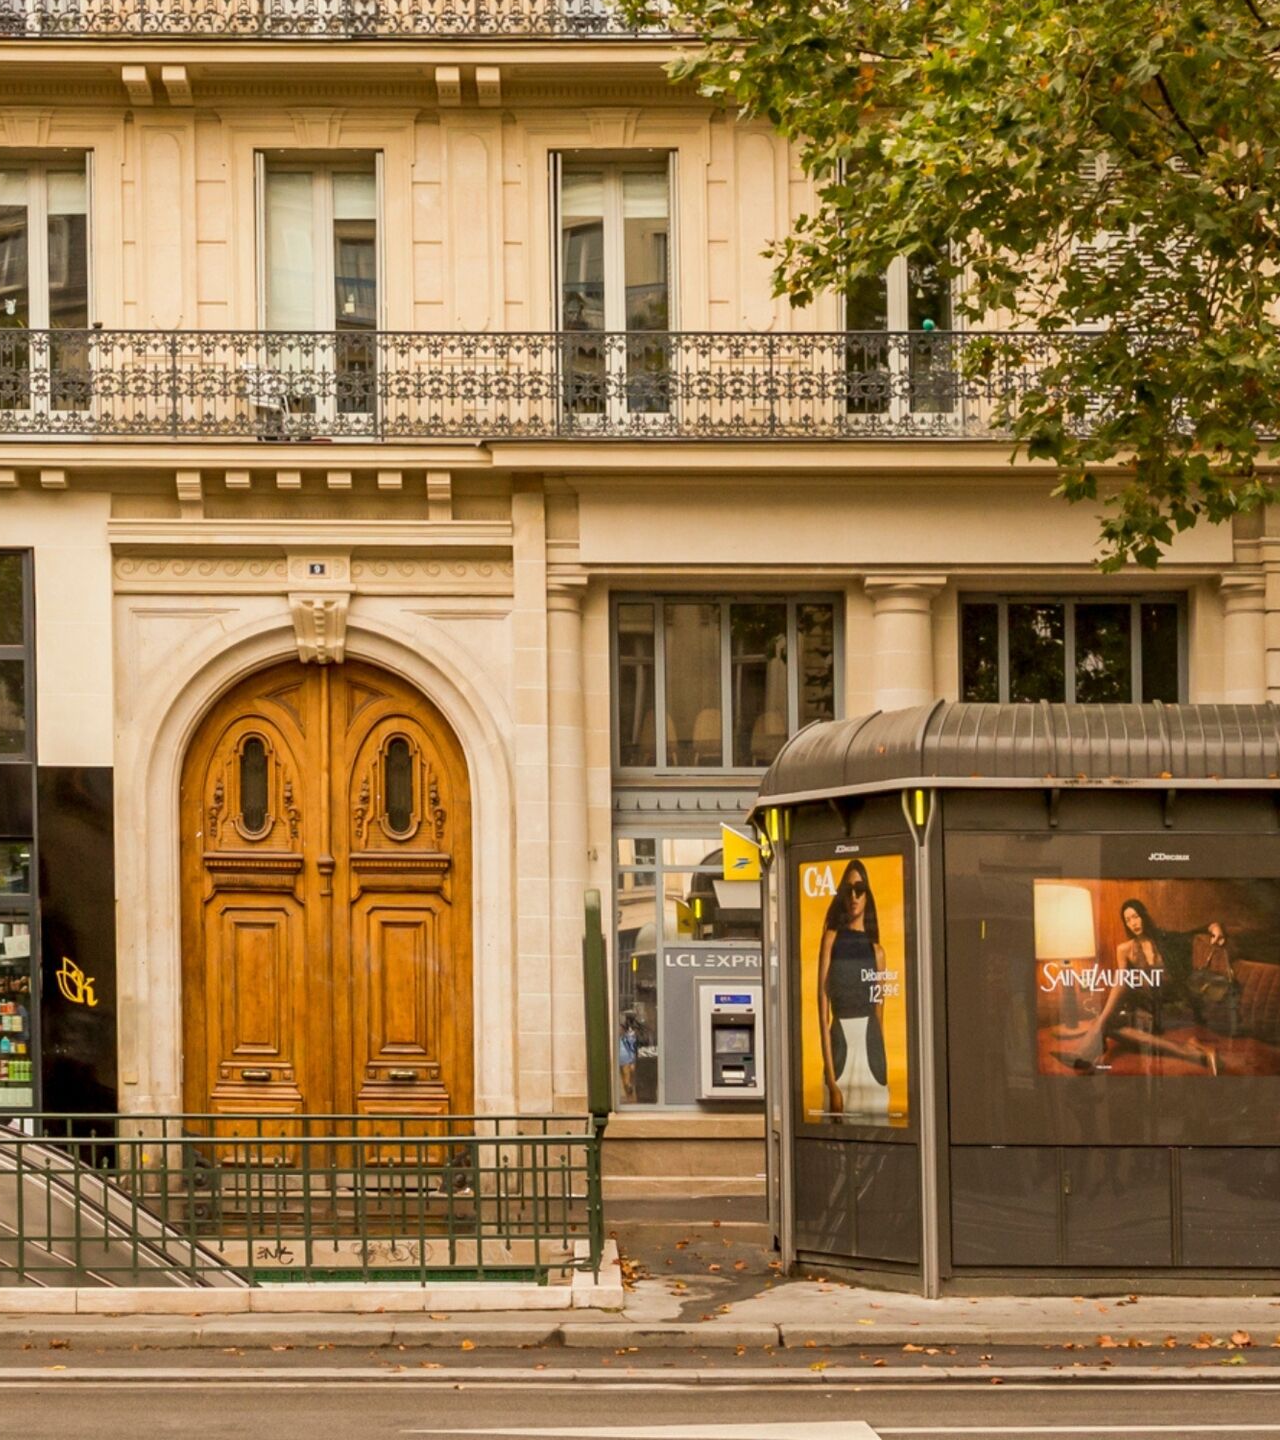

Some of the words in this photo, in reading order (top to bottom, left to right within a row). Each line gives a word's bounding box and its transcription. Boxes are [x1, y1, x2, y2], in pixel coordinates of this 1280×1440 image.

[1148, 853, 1190, 861] JCDecaux
[803, 865, 837, 898] C&A
[665, 954, 700, 967] LCL
[861, 968, 898, 982] Débardeur
[1040, 963, 1096, 992] SAINT
[1090, 963, 1163, 992] LAURENT
